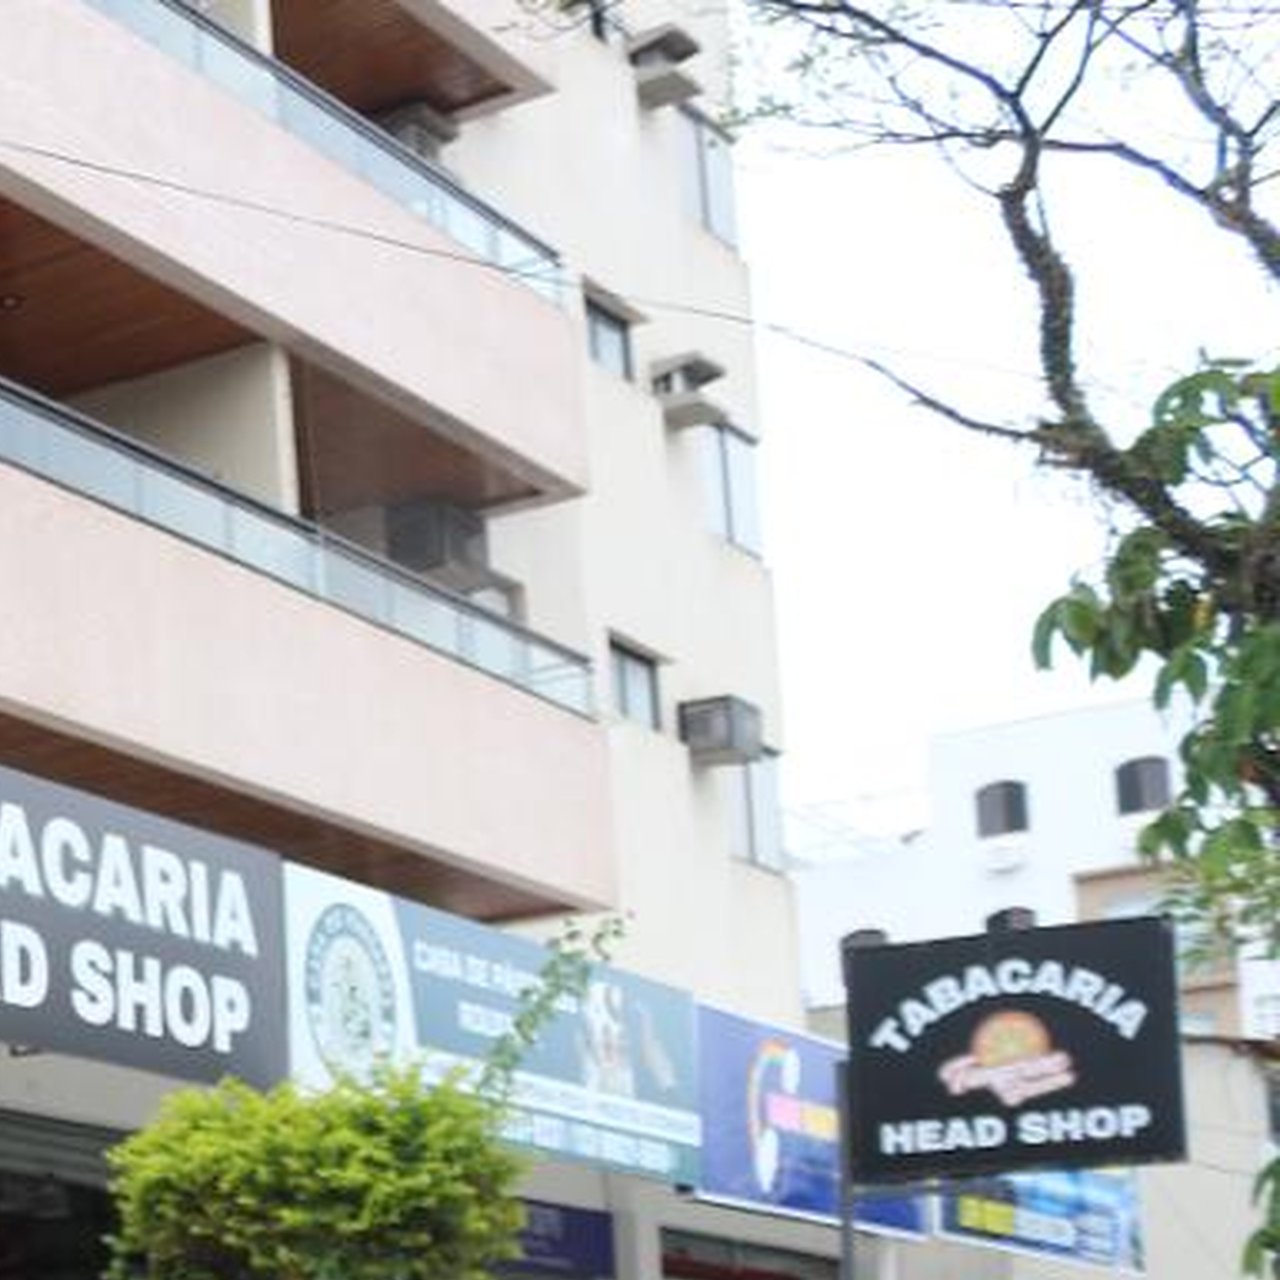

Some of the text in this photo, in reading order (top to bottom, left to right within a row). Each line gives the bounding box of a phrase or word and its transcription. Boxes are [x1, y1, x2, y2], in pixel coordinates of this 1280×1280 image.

[70, 939, 250, 1053] SHOP
[869, 958, 1149, 1053] TABACARIA
[879, 1116, 1007, 1155] HEAD
[1016, 1105, 1151, 1145] SHOP
